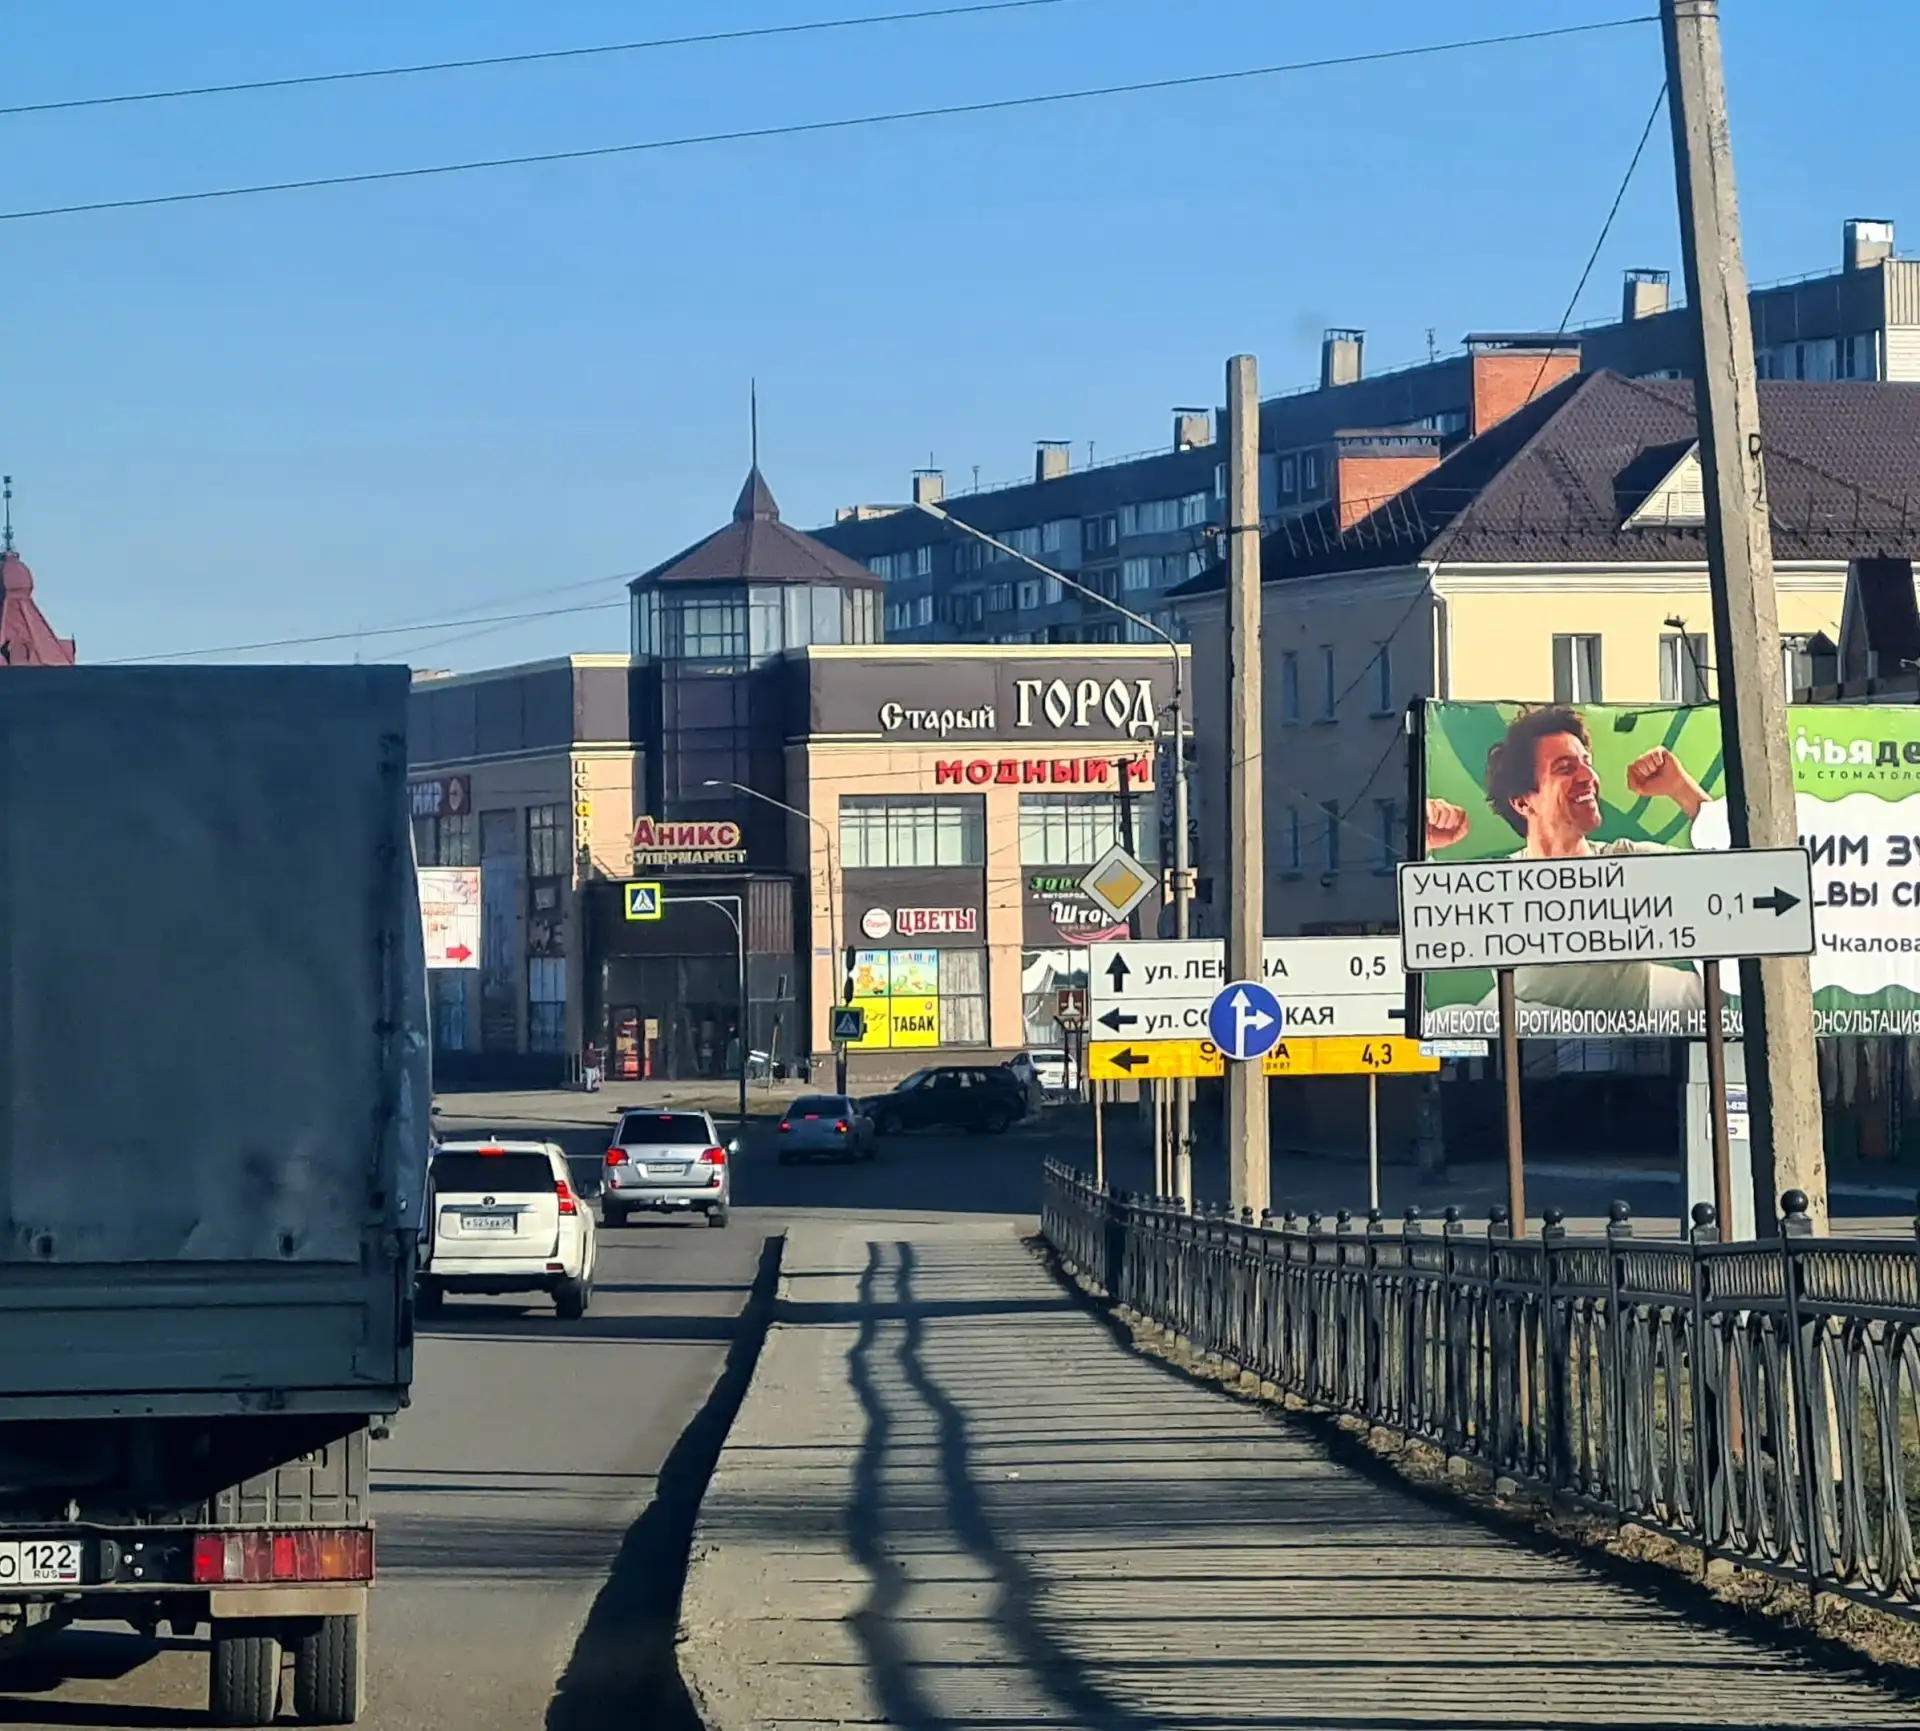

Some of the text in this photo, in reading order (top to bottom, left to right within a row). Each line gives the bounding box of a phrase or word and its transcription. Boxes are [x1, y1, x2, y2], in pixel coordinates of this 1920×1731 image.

[880, 678, 1160, 740] Старый ГОРОД
[935, 755, 1156, 785] МОДНЫЙ М
[1799, 834, 1868, 867] ИМ
[1413, 862, 1625, 896] УЧАСТКОВЫЙ
[898, 909, 977, 934] ЦВЕТЫ
[1051, 902, 1128, 927] Штор
[1413, 892, 1744, 928] ПУНКТ ПОЛИЦИИ 0,1
[1416, 940, 1474, 964] пер.
[1145, 965, 1179, 985] ул.
[1350, 956, 1387, 980] 0,5
[893, 1015, 935, 1033] ТАБАК
[1145, 1014, 1179, 1034] ул.
[1361, 1043, 1393, 1068] 4,3
[24, 1544, 72, 1570] 122
[33, 1569, 58, 1579] RUS
